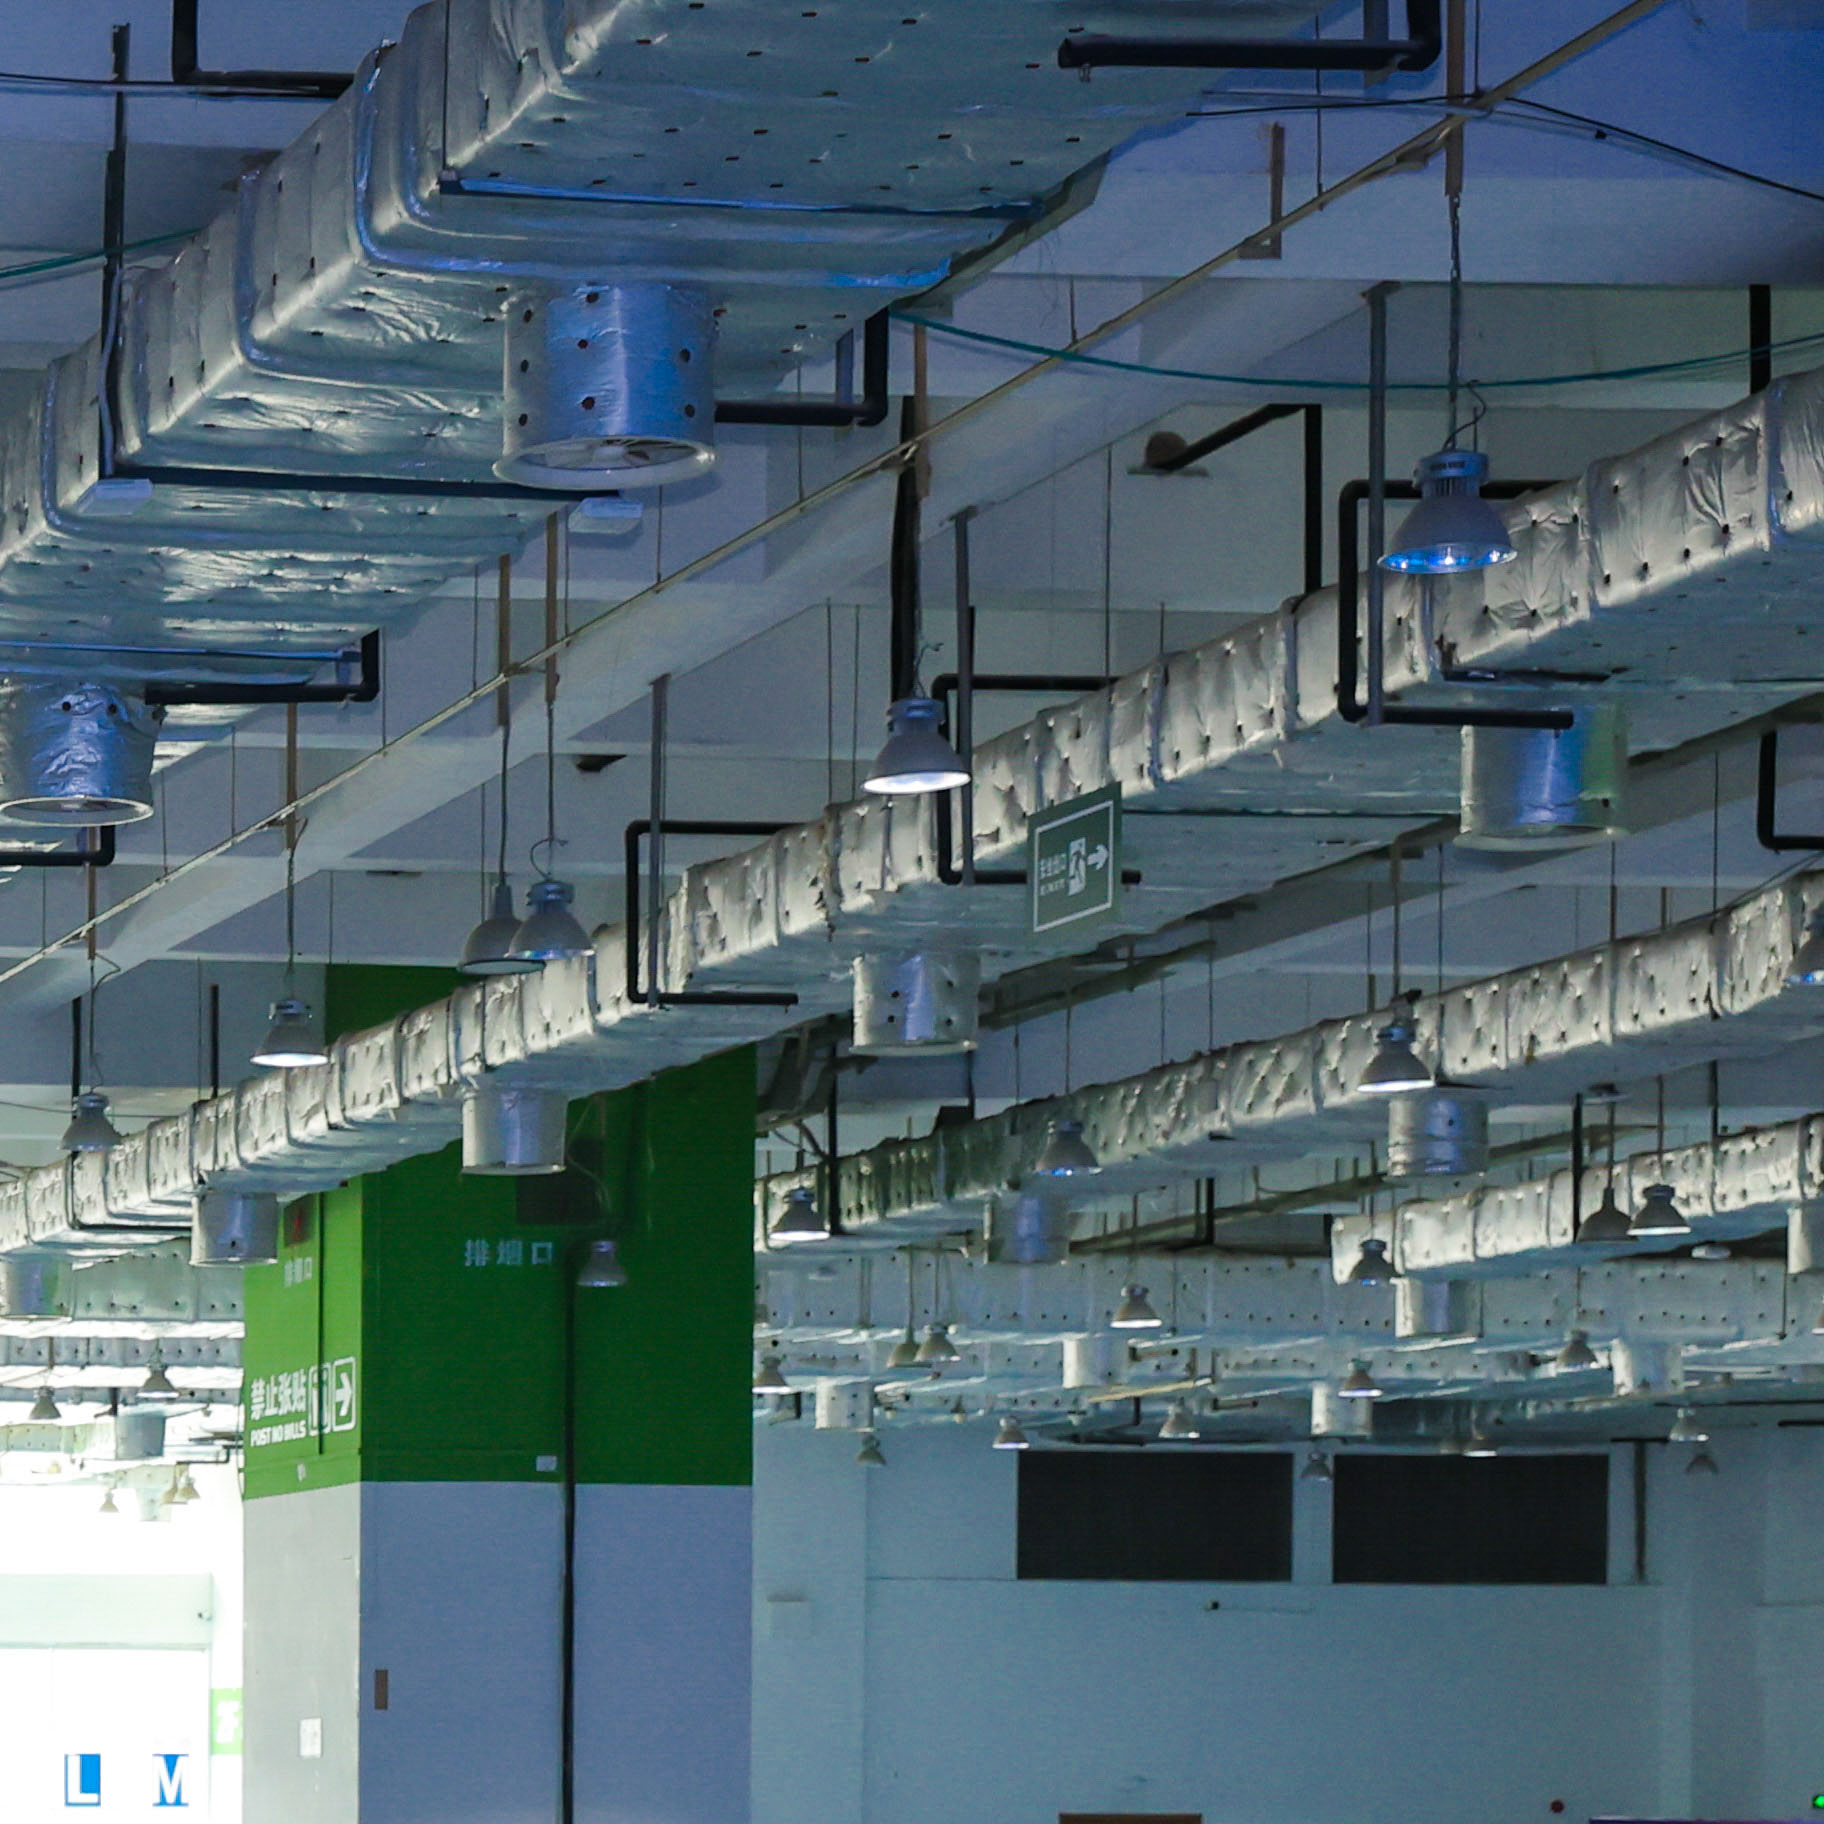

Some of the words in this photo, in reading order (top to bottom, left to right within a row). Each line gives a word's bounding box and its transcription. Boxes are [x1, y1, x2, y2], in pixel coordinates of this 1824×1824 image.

[250, 1369, 306, 1421] 禁止张贴
[250, 1426, 271, 1446] POST
[271, 1424, 283, 1443] NO
[283, 1420, 306, 1441] BILLS
[65, 1754, 101, 1806] L
[152, 1754, 189, 1806] M
